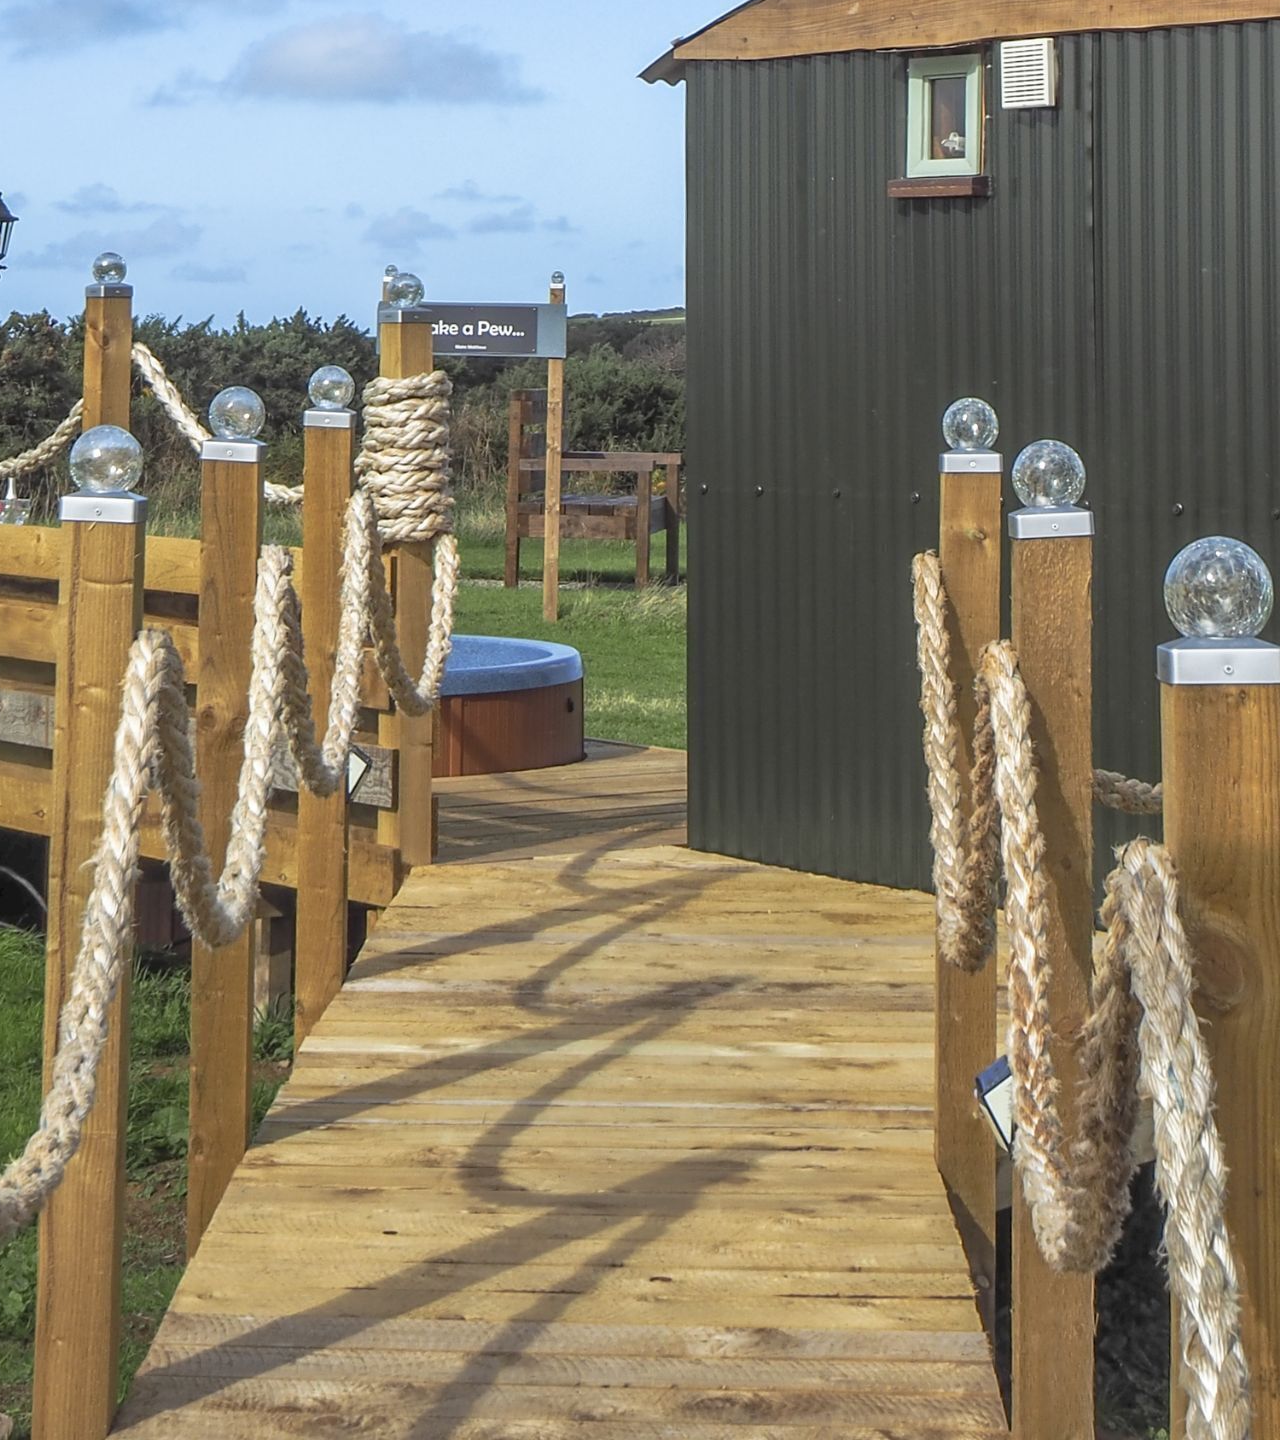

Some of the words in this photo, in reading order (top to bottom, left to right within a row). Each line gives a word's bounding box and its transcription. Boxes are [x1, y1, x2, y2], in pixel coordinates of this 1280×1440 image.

[431, 320, 459, 336] ake
[462, 324, 474, 336] a
[477, 320, 525, 337] Pew...
